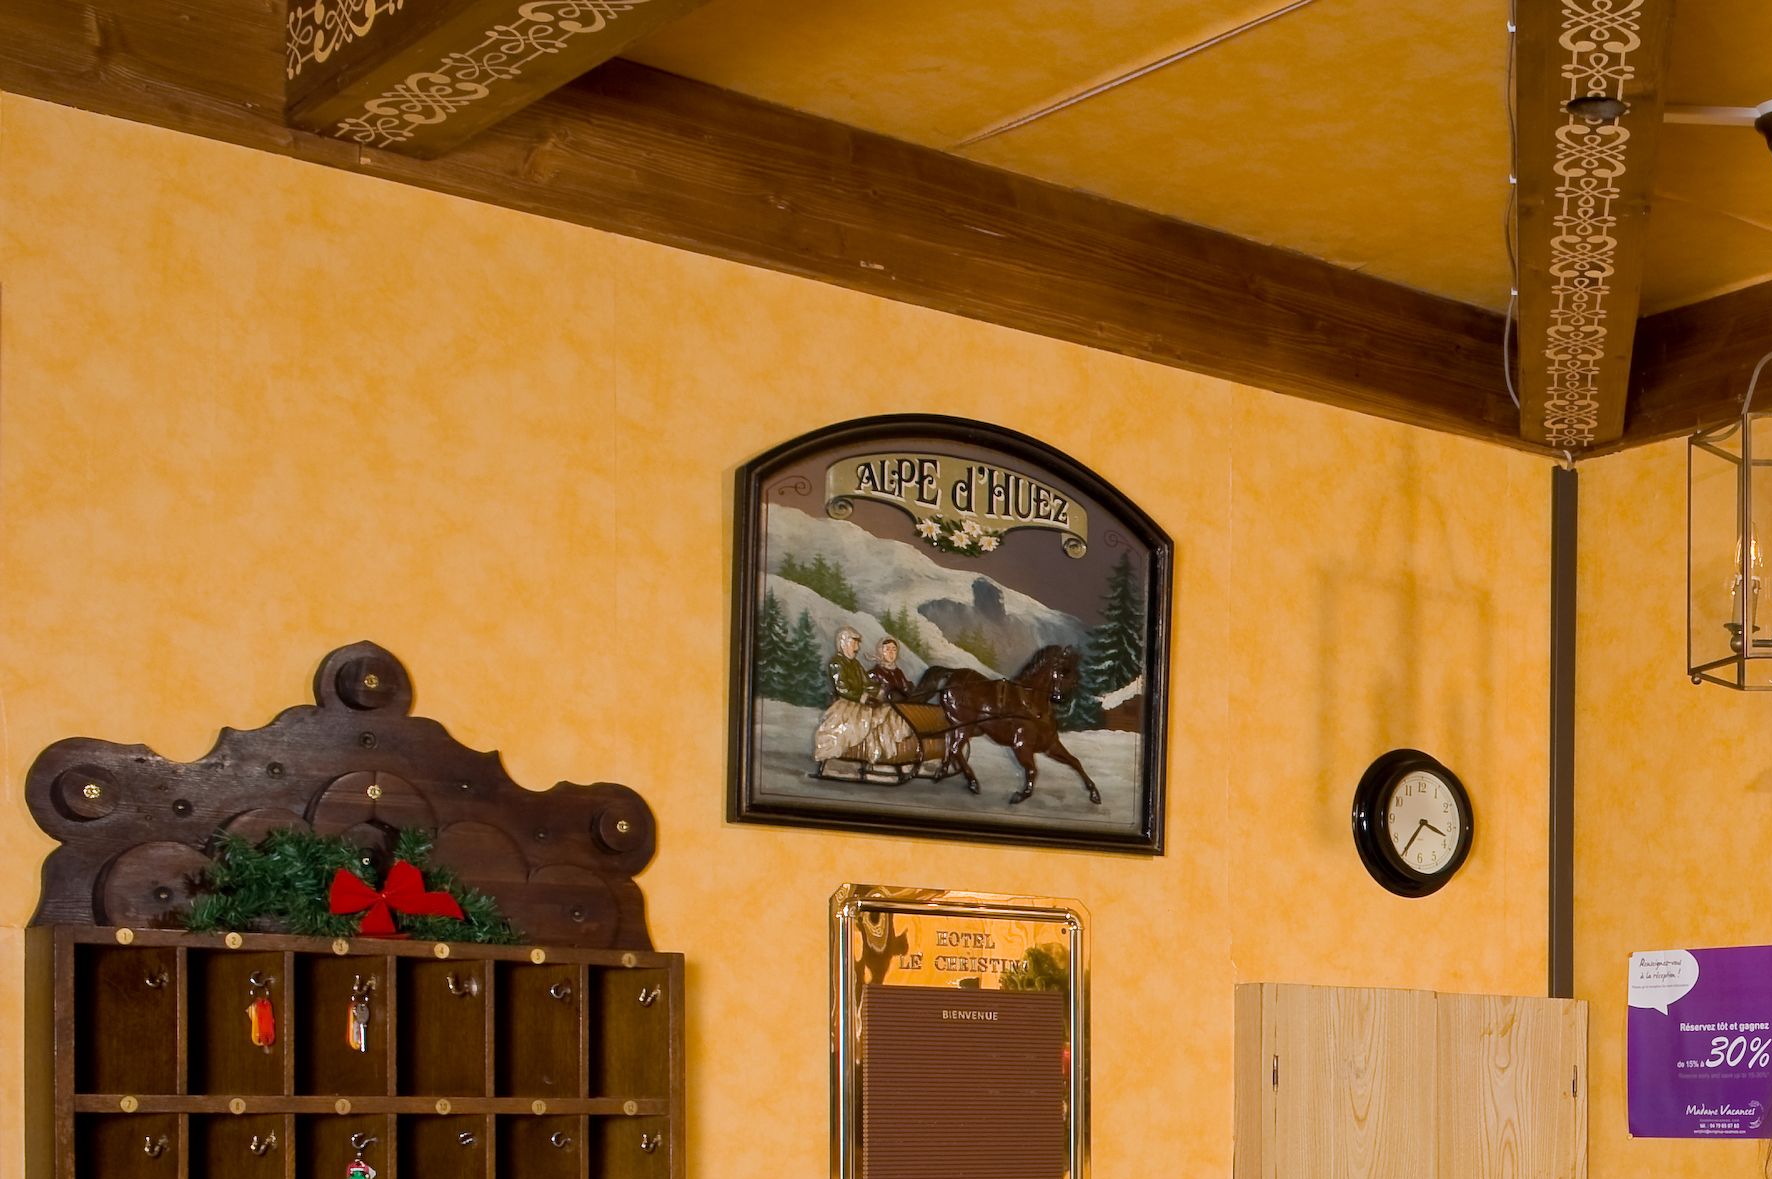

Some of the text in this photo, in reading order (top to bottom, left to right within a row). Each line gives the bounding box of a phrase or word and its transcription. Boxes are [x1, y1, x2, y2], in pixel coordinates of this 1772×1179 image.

[855, 458, 1069, 528] ALPE d'HUEZ
[1405, 785, 1412, 797] 11
[1417, 781, 1427, 793] 12
[1395, 796, 1403, 807] 10
[1443, 803, 1449, 813] 2
[1389, 813, 1395, 824] 9
[1446, 822, 1452, 832] 3
[1393, 832, 1399, 843] 8
[1417, 852, 1423, 864] 6
[1431, 851, 1437, 861] 5
[935, 930, 996, 950] HOTEL
[898, 953, 924, 970] LE
[942, 1009, 998, 1021] BIENVENUE
[1680, 1021, 1770, 1032] Réservez tôt et gagnez
[1686, 1060, 1699, 1068] 15%
[1705, 1035, 1772, 1069] 30%
[536, 1103, 543, 1112] 11
[1685, 1103, 1756, 1116] Madame Vacances
